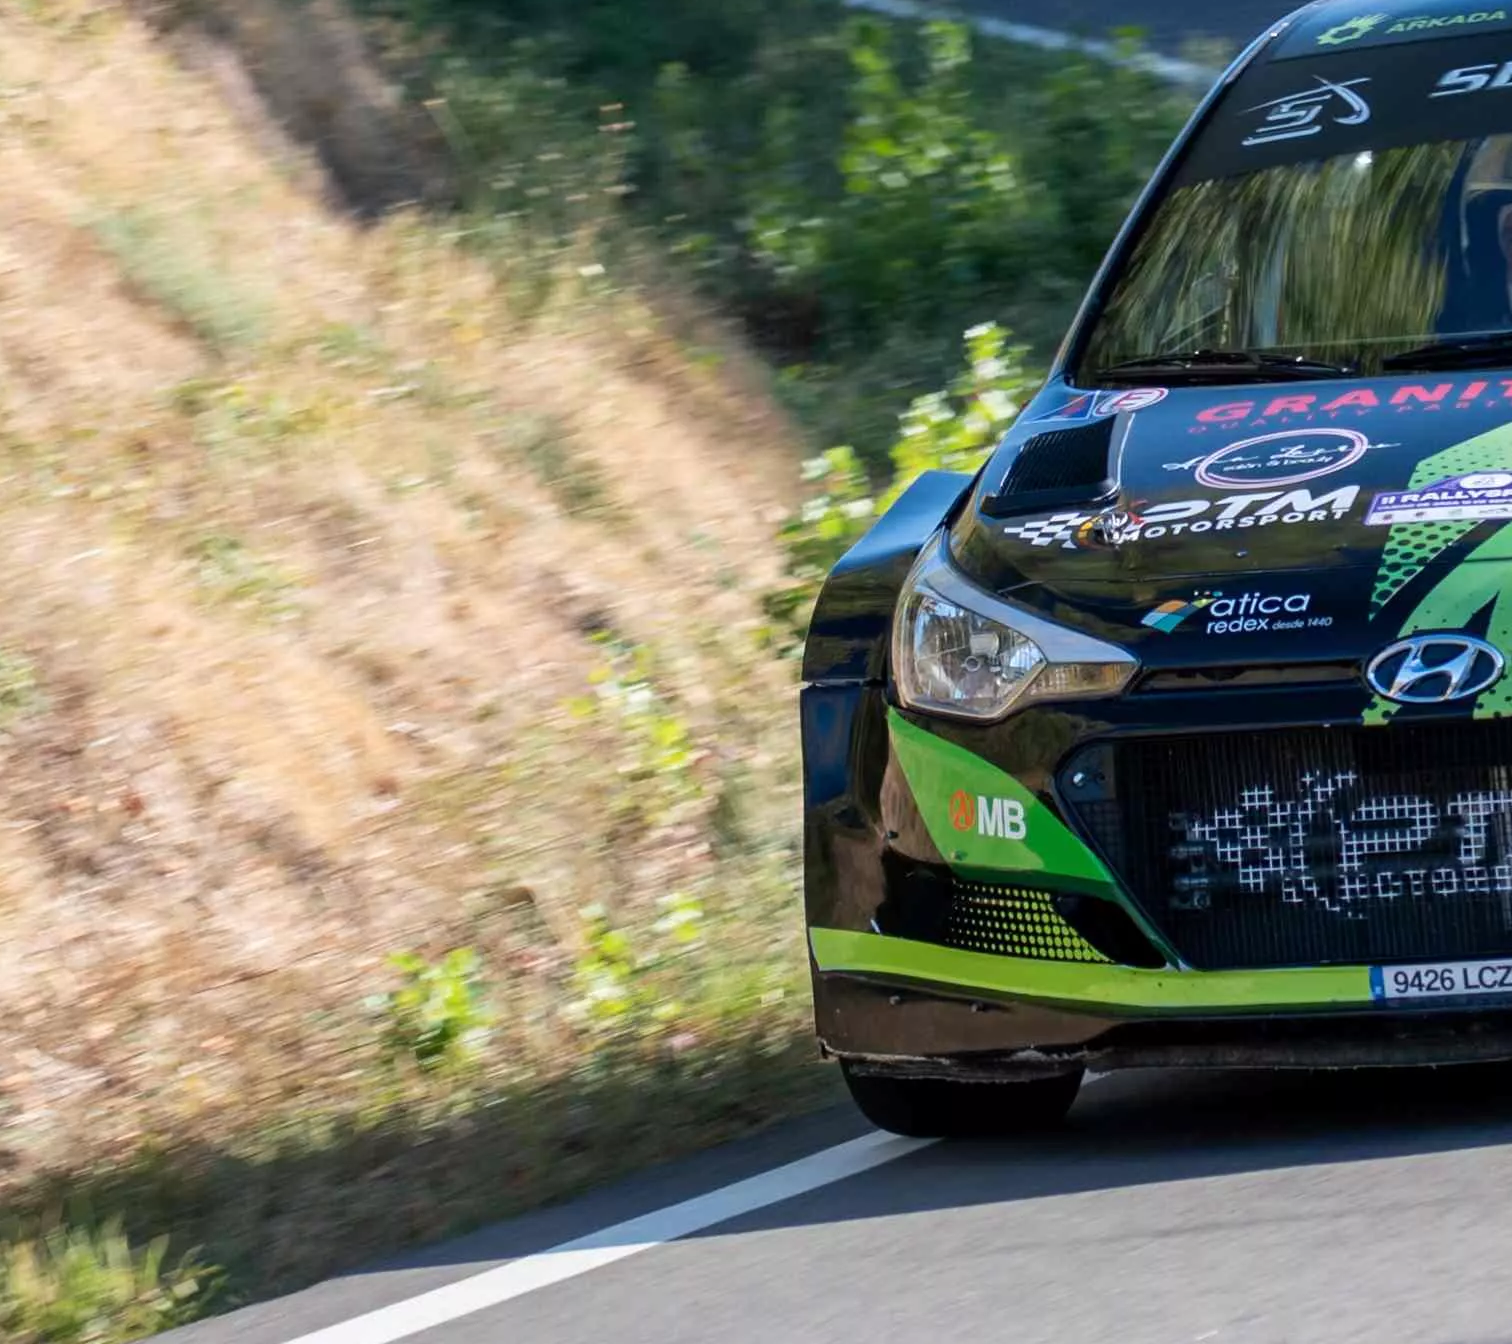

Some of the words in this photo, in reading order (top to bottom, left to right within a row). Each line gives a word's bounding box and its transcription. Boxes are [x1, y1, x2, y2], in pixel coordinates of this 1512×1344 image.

[1384, 10, 1507, 34] ARKADA
[1119, 507, 1352, 543] MOTORSPORT
[1206, 616, 1270, 634] redex
[1272, 619, 1305, 630] desde
[977, 795, 1027, 840] MB
[1393, 968, 1456, 994] 9426
